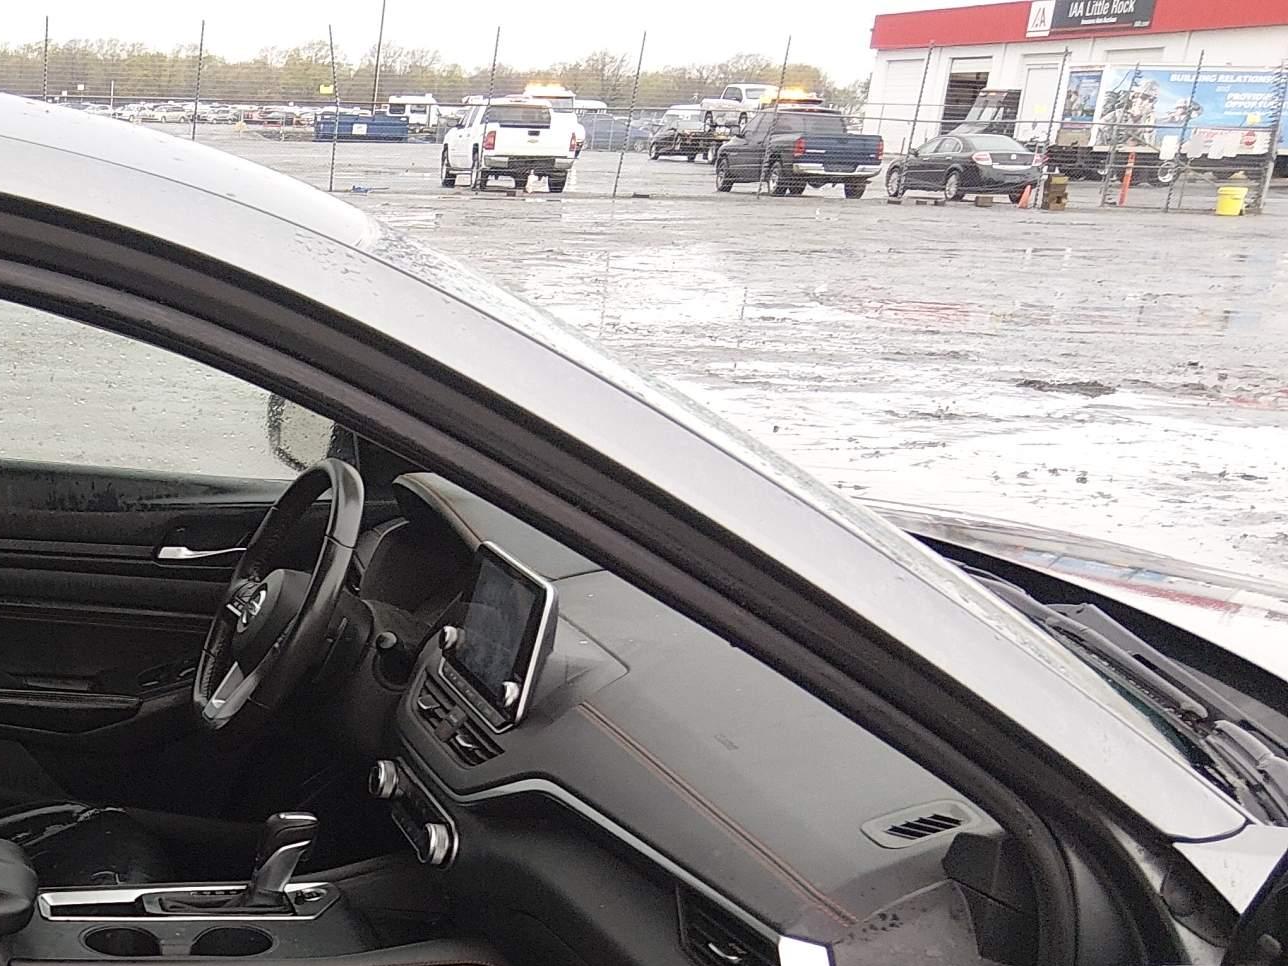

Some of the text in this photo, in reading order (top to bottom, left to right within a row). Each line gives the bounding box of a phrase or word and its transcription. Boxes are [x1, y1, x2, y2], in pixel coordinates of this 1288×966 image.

[1068, 0, 1136, 18] IAA Little Rock
